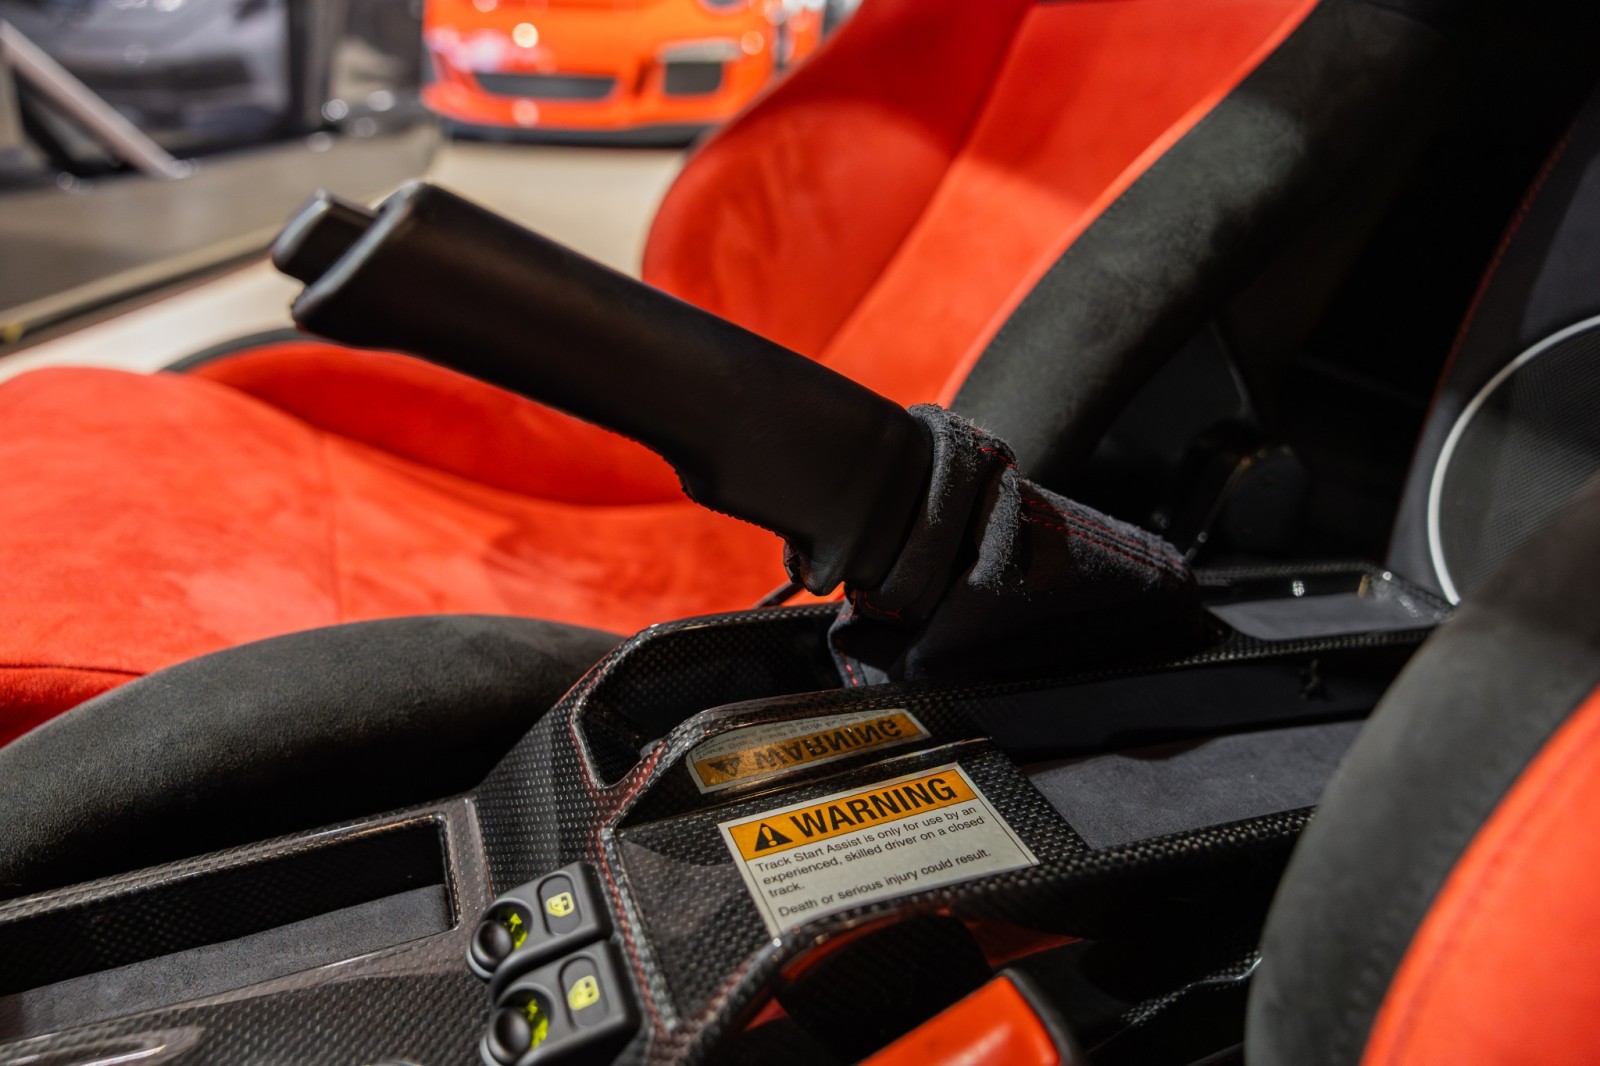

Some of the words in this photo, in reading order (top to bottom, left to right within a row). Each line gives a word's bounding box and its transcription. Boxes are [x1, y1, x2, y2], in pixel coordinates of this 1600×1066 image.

[755, 856, 792, 872] Track
[793, 847, 824, 862] Start
[827, 836, 862, 853] Assist
[863, 833, 875, 843] is
[877, 826, 901, 839] only
[903, 822, 920, 832] for
[921, 816, 943, 827] use
[944, 811, 960, 821] by
[961, 806, 977, 816] an
[789, 778, 958, 838] WARNING
[762, 856, 843, 885] experienced,
[844, 844, 883, 863] skilled
[884, 835, 917, 851] driver
[920, 831, 936, 841] on
[937, 828, 947, 836] a
[947, 816, 985, 833] closed
[778, 898, 818, 917] Death
[821, 894, 835, 905] or
[838, 879, 884, 900] serious
[884, 870, 918, 886] injury
[920, 858, 954, 875] could
[955, 849, 991, 866] result.
[768, 882, 805, 898] track.
